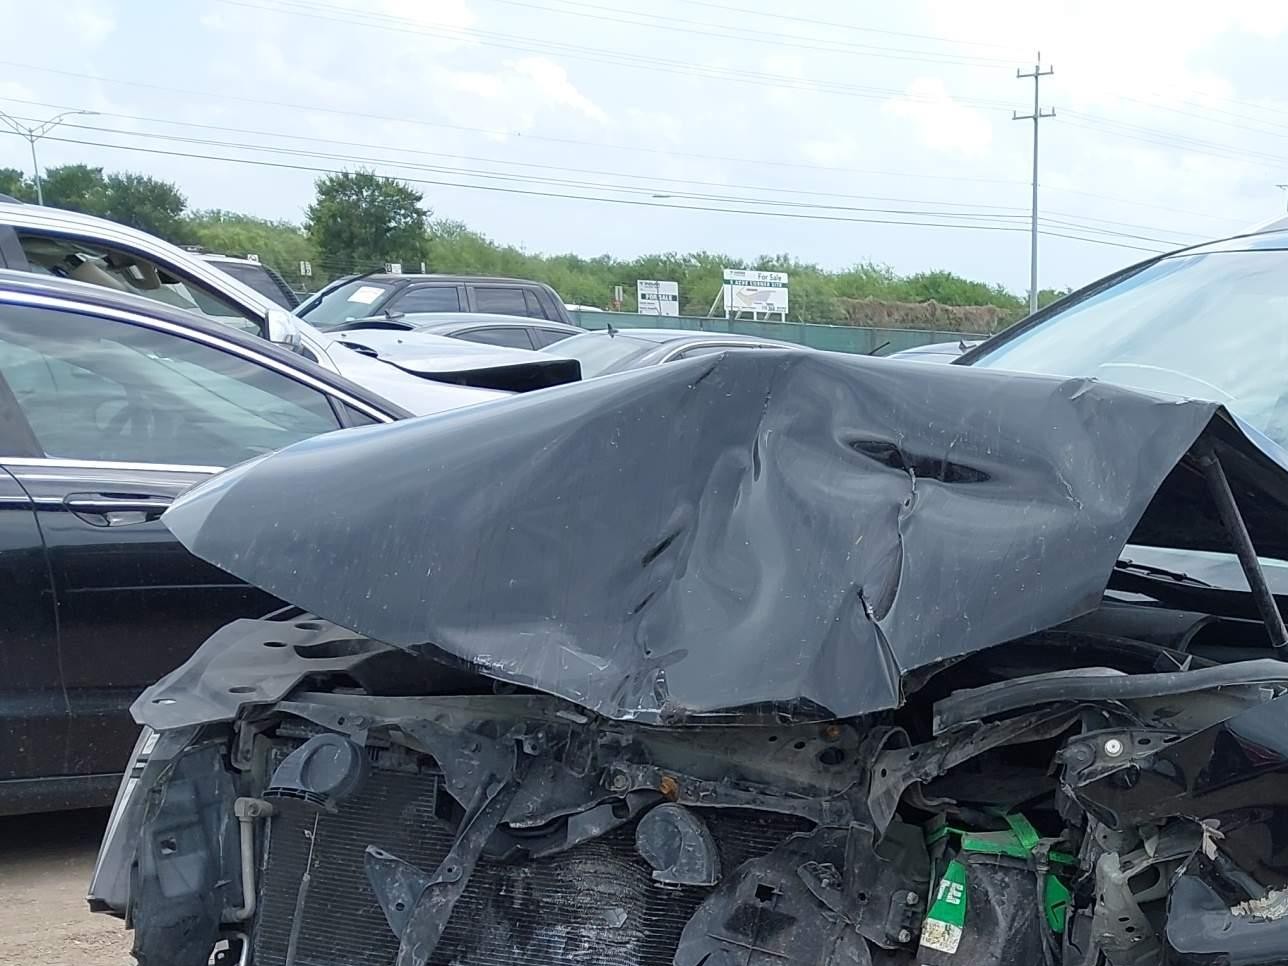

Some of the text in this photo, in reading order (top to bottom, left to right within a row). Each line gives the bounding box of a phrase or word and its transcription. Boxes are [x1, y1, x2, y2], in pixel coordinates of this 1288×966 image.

[757, 272, 782, 282] For Sale
[645, 293, 672, 302] FOR SALE
